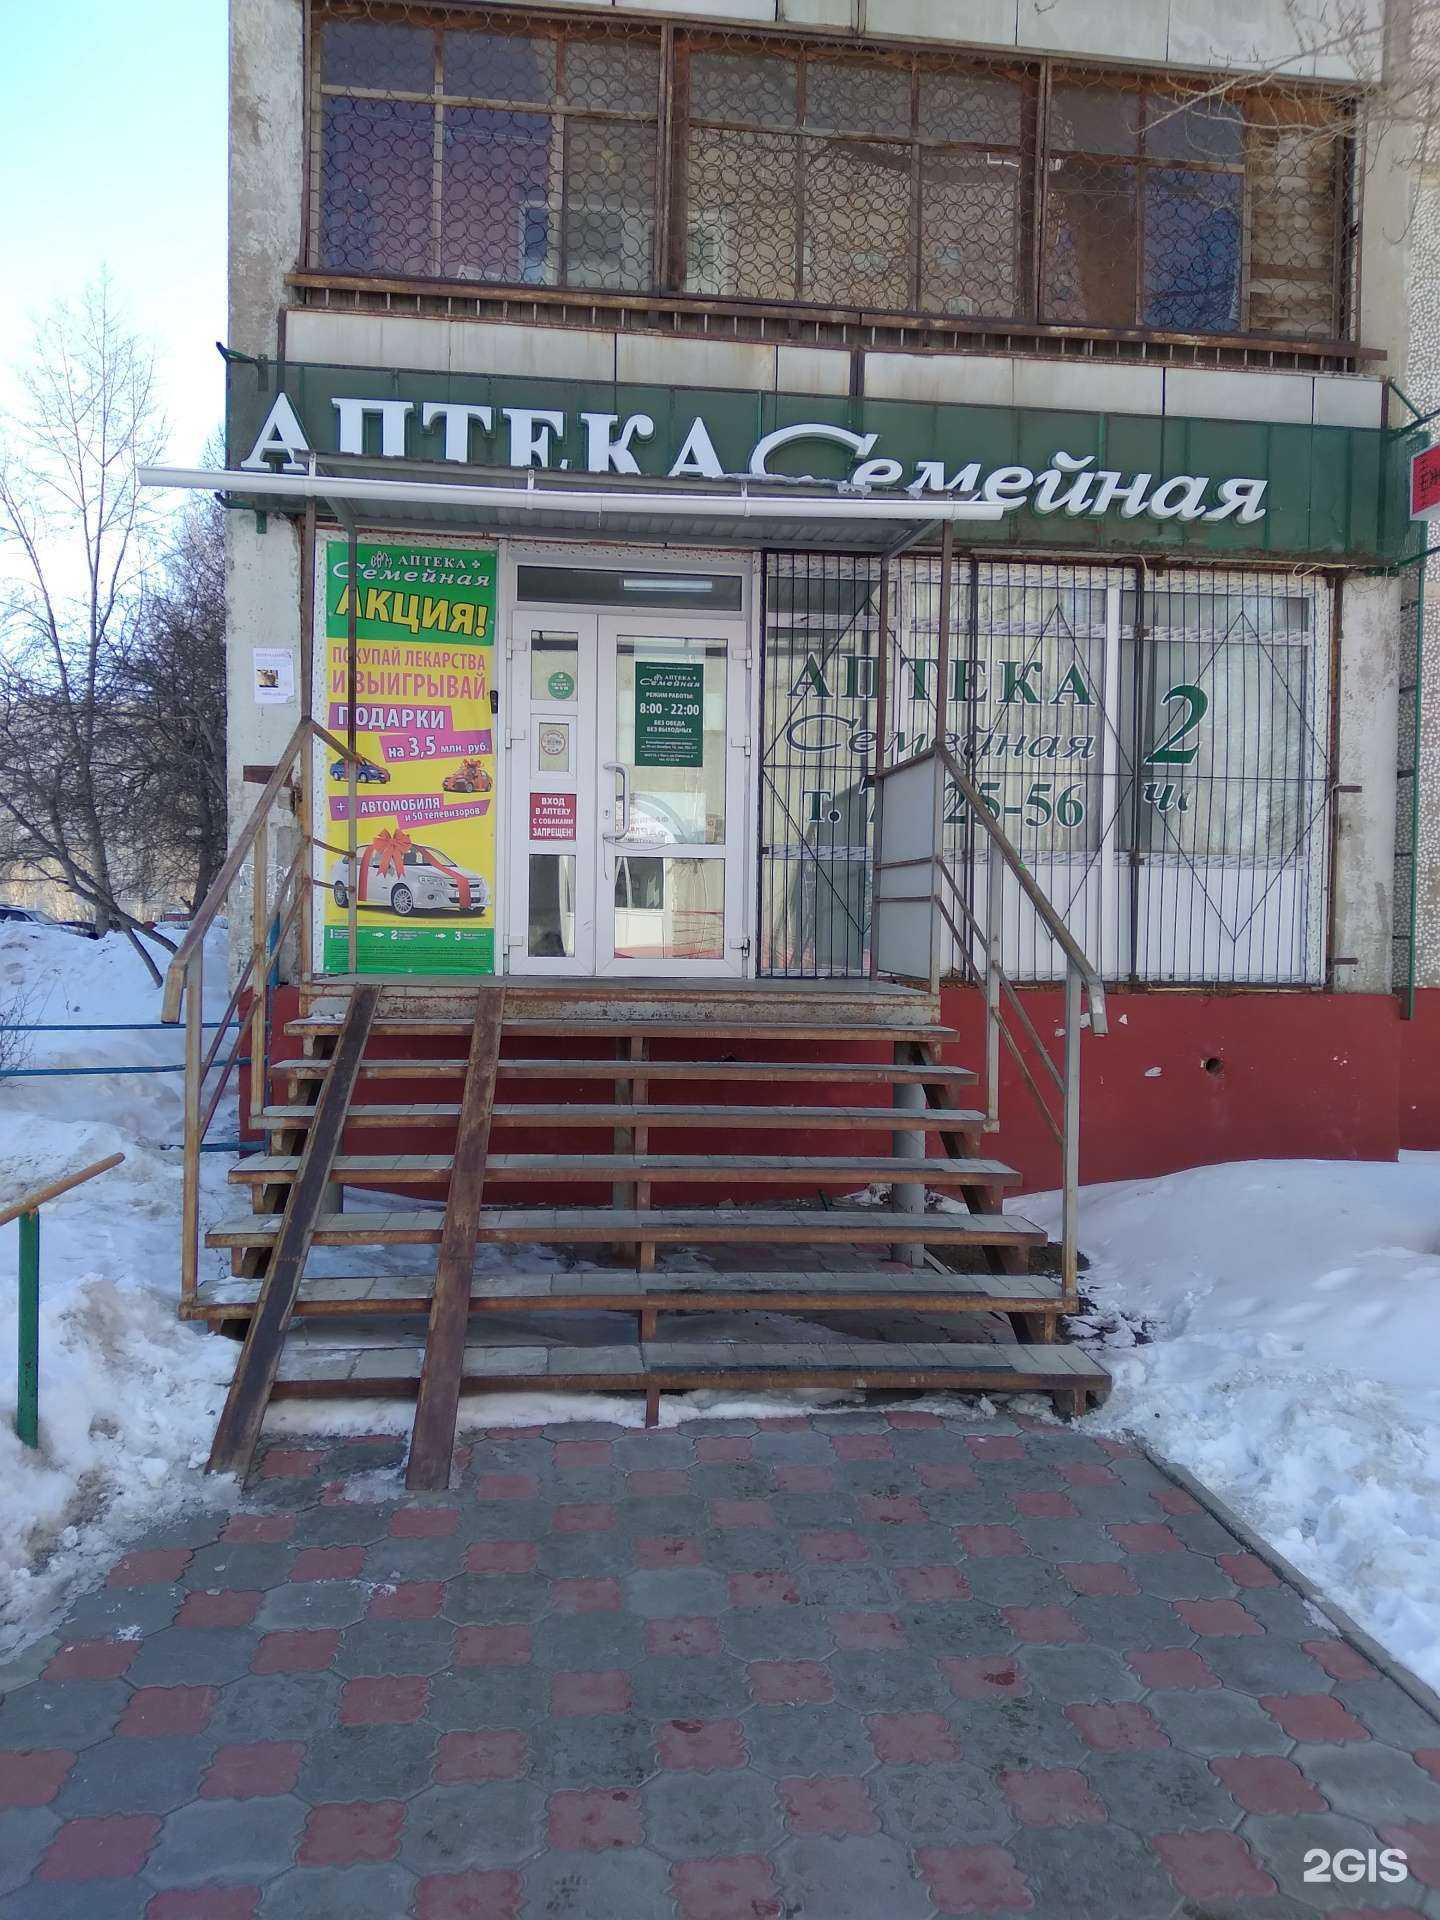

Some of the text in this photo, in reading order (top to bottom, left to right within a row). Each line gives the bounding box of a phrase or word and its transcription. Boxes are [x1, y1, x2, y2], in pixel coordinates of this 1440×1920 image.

[241, 392, 1268, 523] АПТЕКА Семейная
[399, 554, 466, 569] АПТЕКА
[332, 561, 490, 587] Семейная
[335, 584, 488, 638] АКЦИЯ!
[404, 650, 485, 671] ЛЕКАРСТВА
[332, 670, 486, 700] И ВЫИГРЫВАЙ
[786, 651, 1097, 706] АПТЕКА
[640, 702, 662, 714] 8:00
[671, 703, 700, 715] 22:00
[388, 735, 489, 757] на 3,5 млн. руб.
[785, 713, 1096, 760] Семейная
[360, 797, 440, 813] АВТОМОБИЛЯ
[535, 807, 571, 815] В АПТЕКУ
[541, 797, 565, 807] ВХОД
[412, 812, 422, 821] 50
[425, 807, 480, 819] телевизоров
[390, 930, 398, 940] 2
